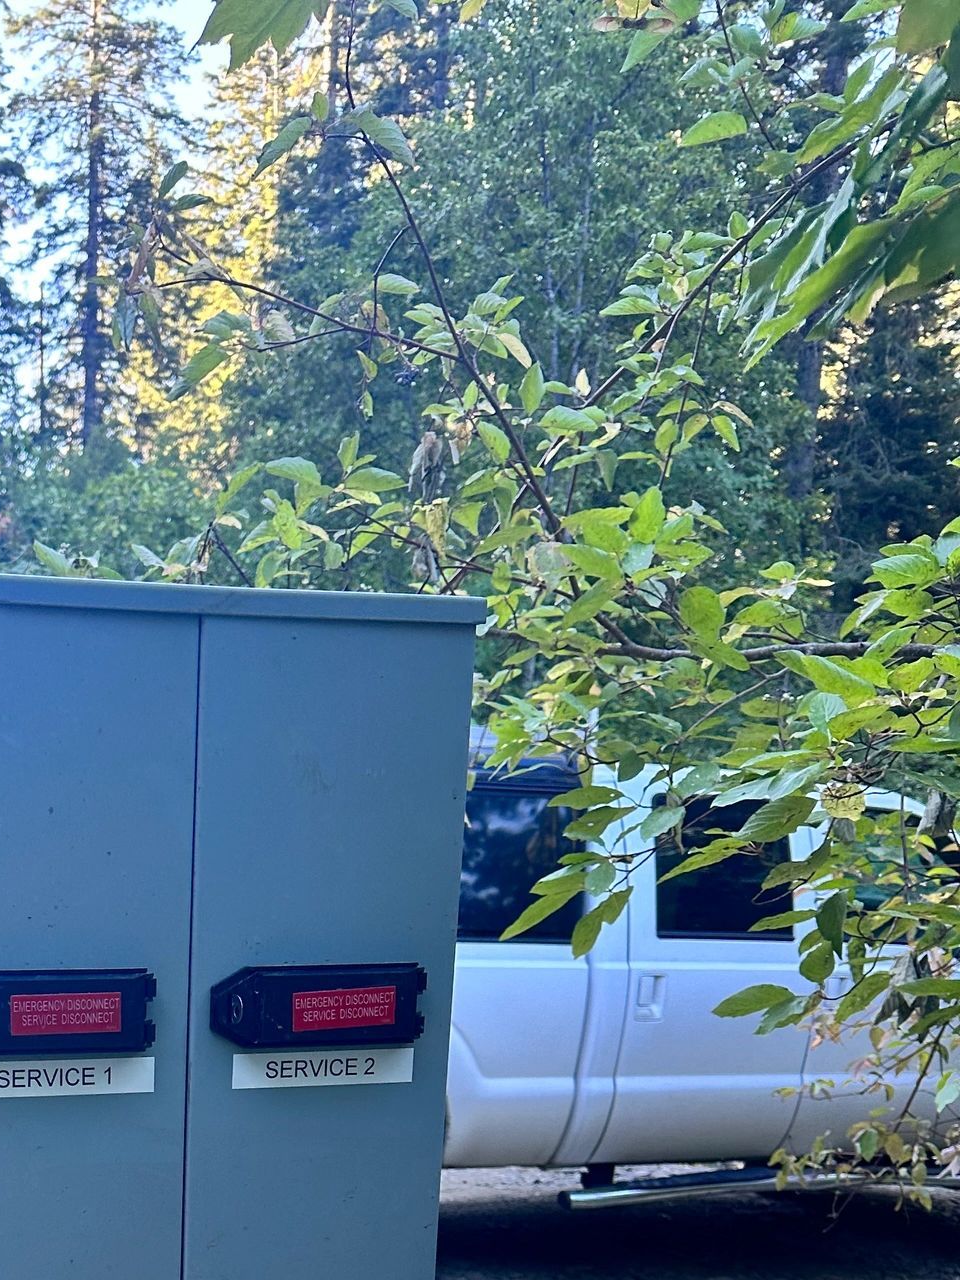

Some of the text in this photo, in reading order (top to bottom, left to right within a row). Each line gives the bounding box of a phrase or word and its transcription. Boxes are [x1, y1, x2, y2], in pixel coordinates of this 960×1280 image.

[14, 998, 120, 1013] EMERGENCY DISCONNECT
[296, 992, 394, 1009] EMERGENCY DISCONNECT
[22, 1012, 114, 1026] SERVICE DISCONNECT
[303, 1006, 388, 1022] SERVICE DISCONNECT
[104, 1067, 112, 1084] 1
[266, 1058, 375, 1078] SERVICE 2
